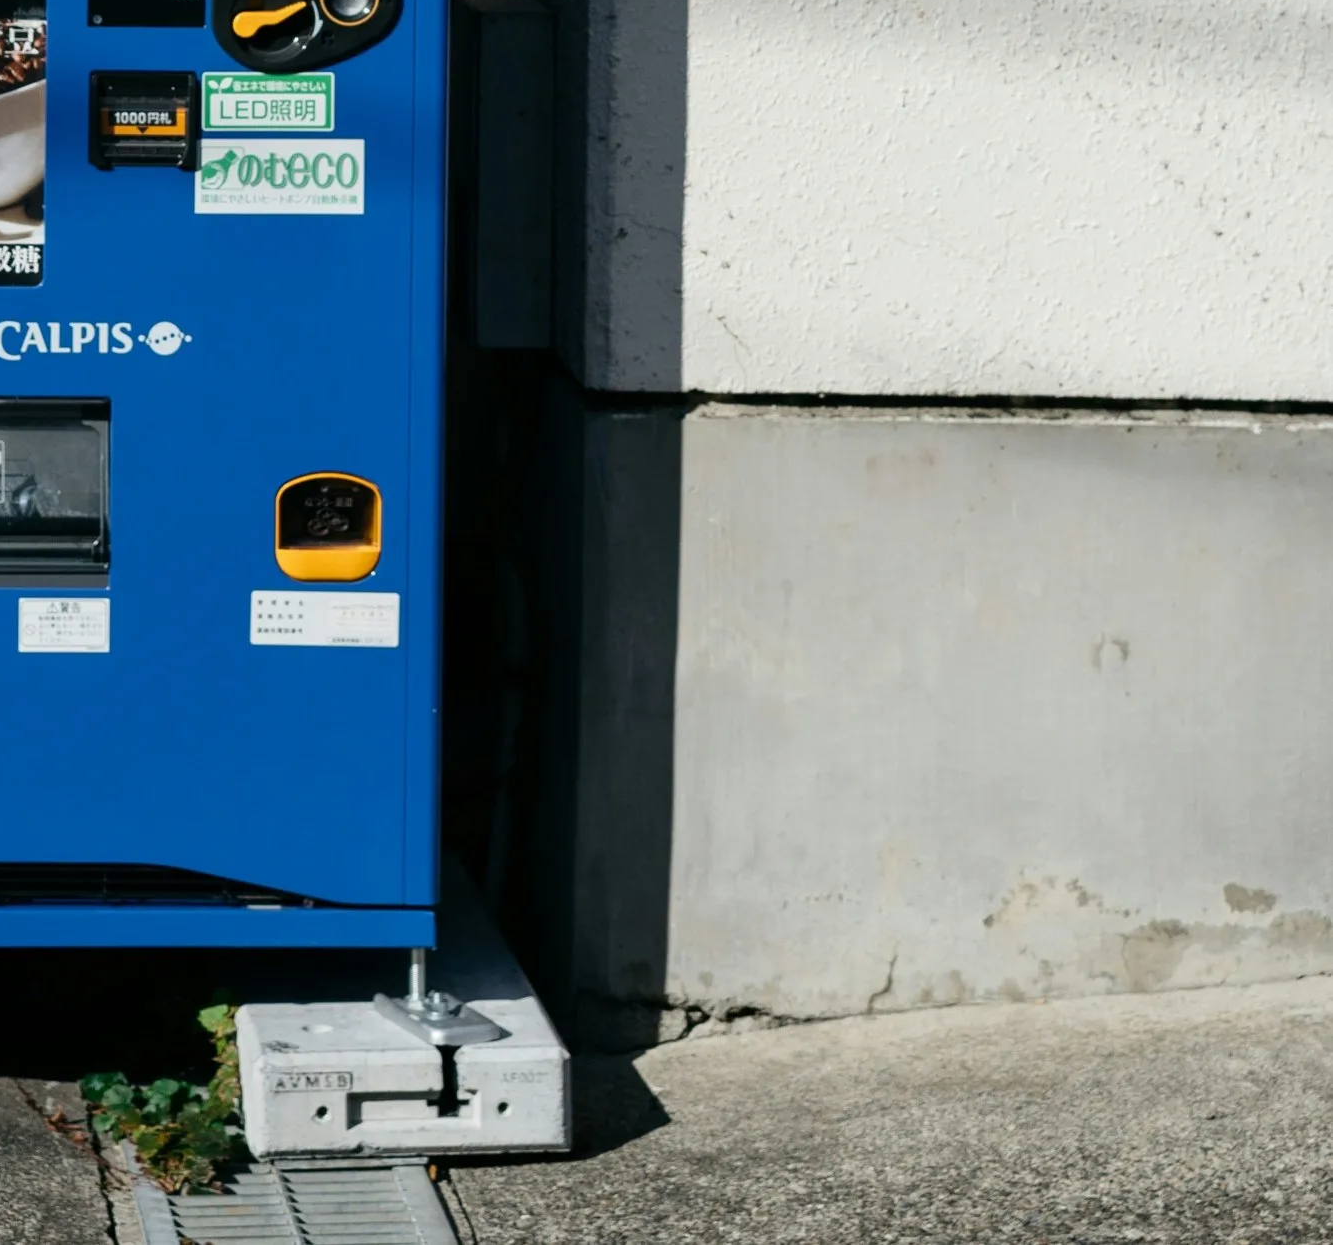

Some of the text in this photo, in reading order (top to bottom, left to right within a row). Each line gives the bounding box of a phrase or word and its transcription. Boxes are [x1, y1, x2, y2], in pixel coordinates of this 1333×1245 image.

[114, 112, 172, 125] 1000円札
[219, 99, 317, 122] LED照明
[238, 152, 359, 190] のむeco
[274, 1075, 349, 1089] AVMSB
